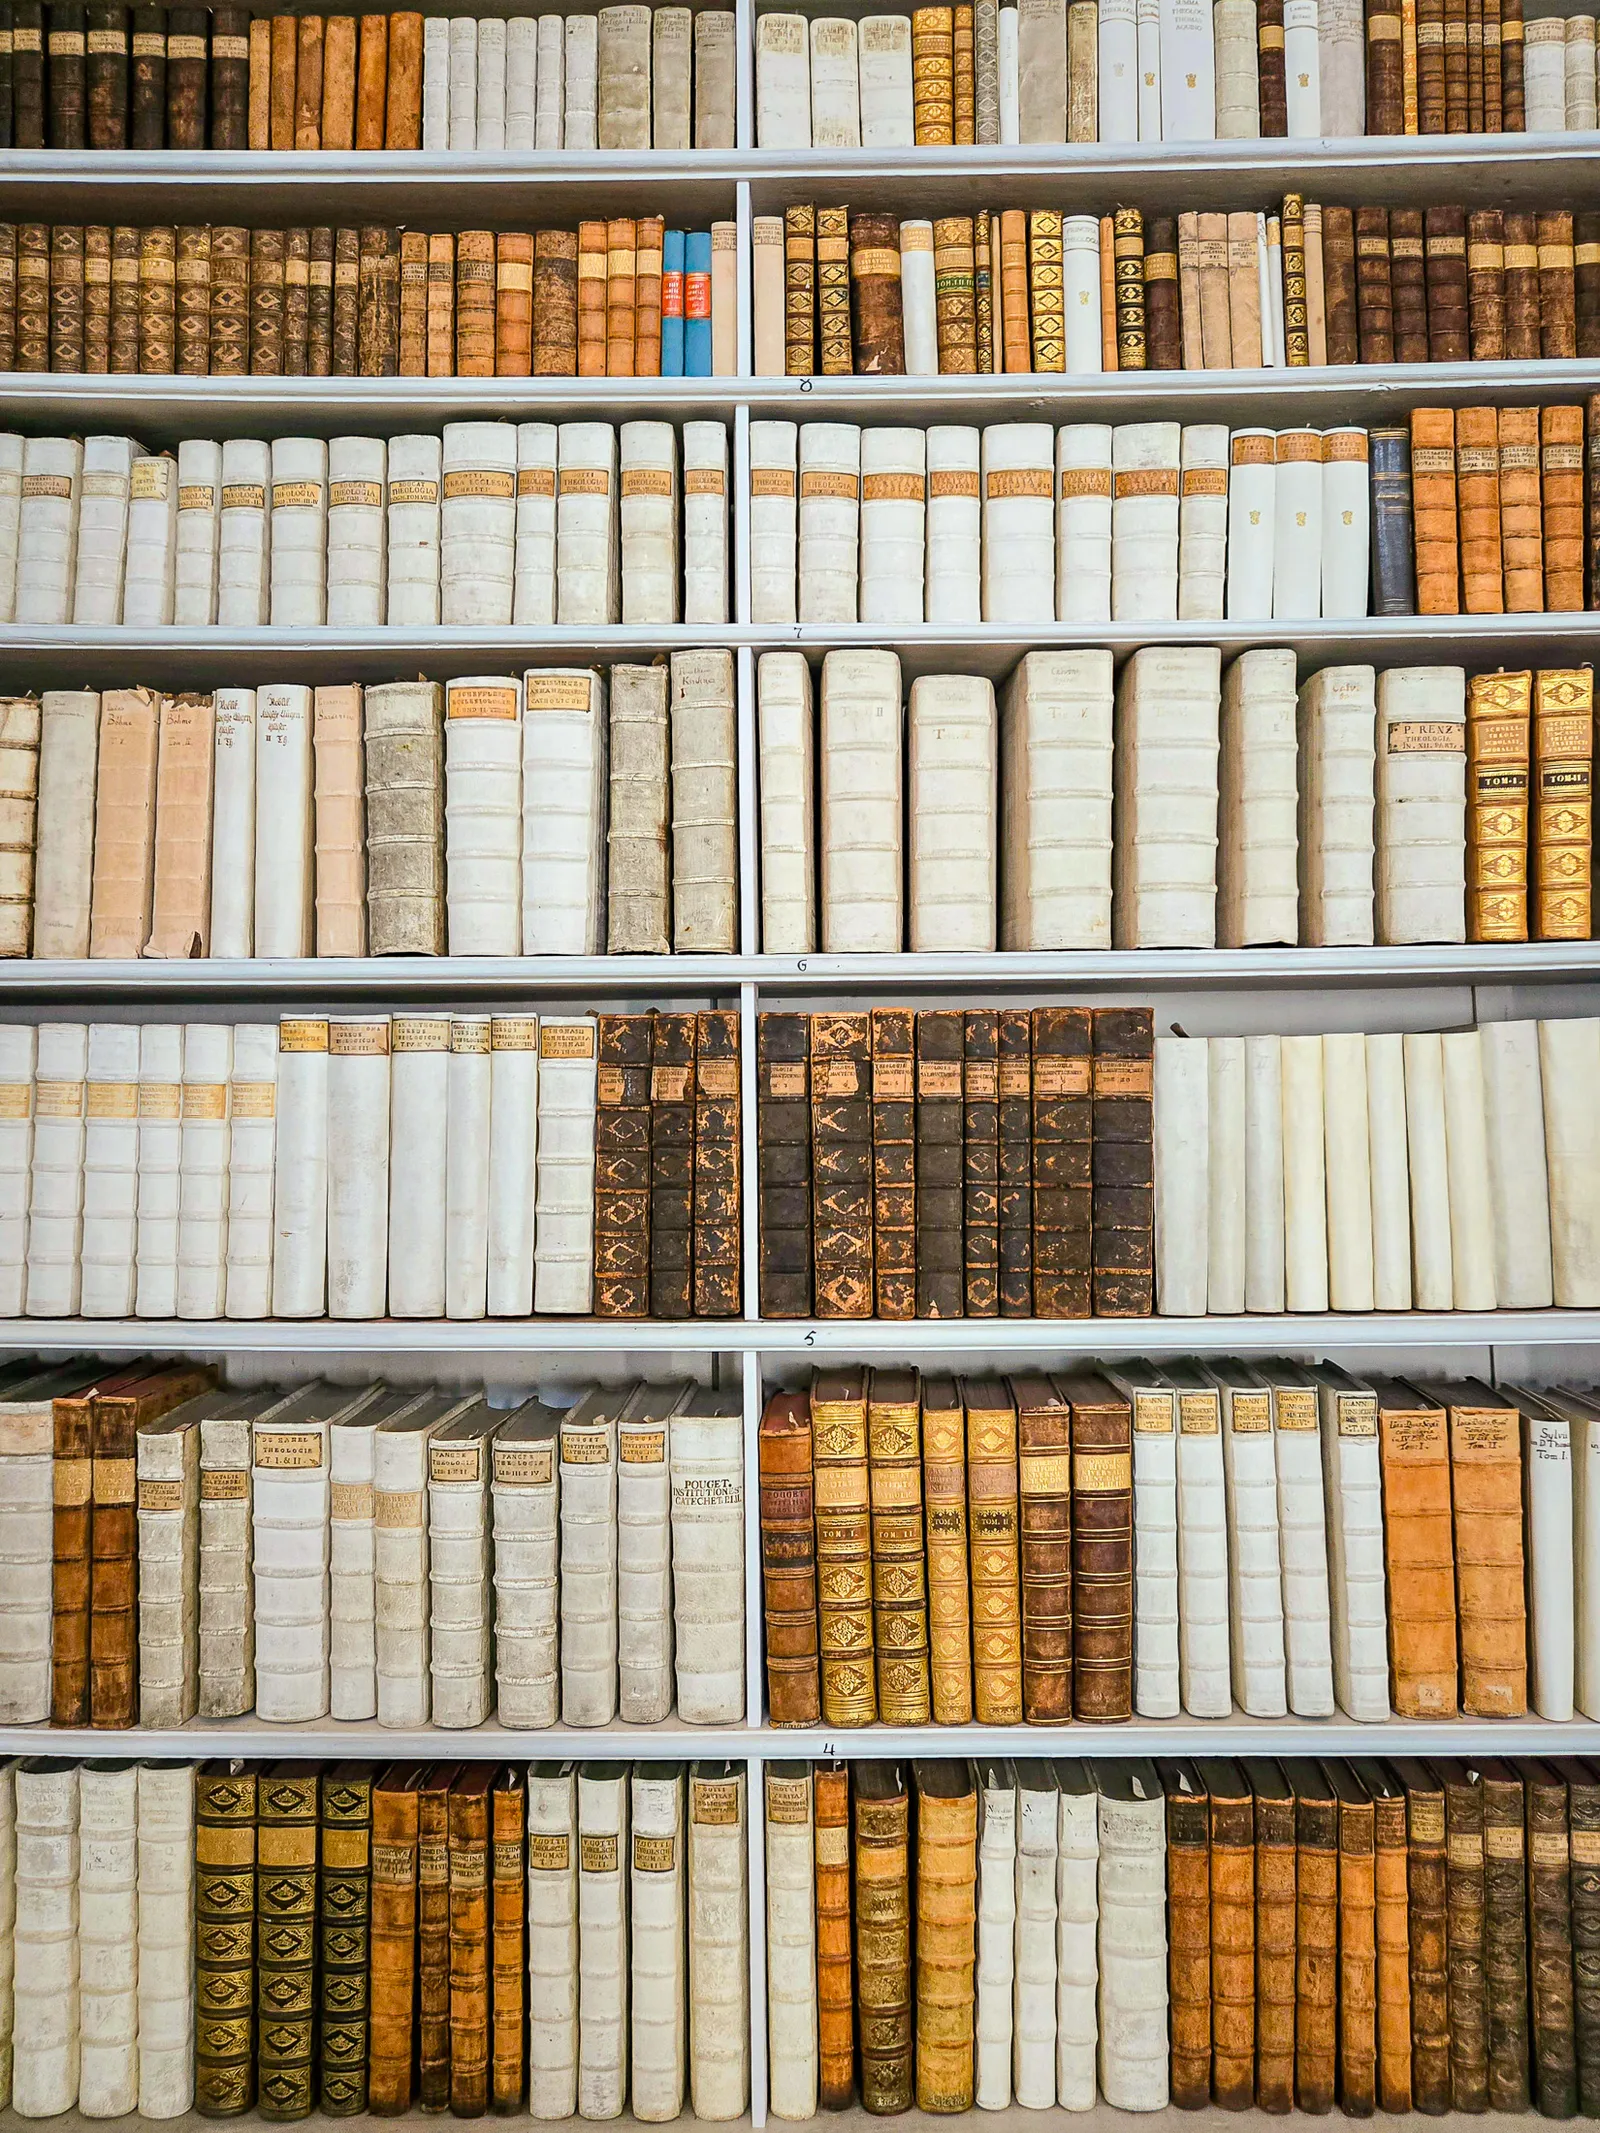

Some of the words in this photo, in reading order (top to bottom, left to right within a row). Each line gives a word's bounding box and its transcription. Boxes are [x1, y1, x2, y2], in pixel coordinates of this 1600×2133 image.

[793, 627, 803, 640] 7
[1419, 724, 1454, 735] RENZ
[805, 1331, 816, 1345] 5
[823, 1529, 847, 1538] TOM.
[823, 1743, 835, 1756] 4
